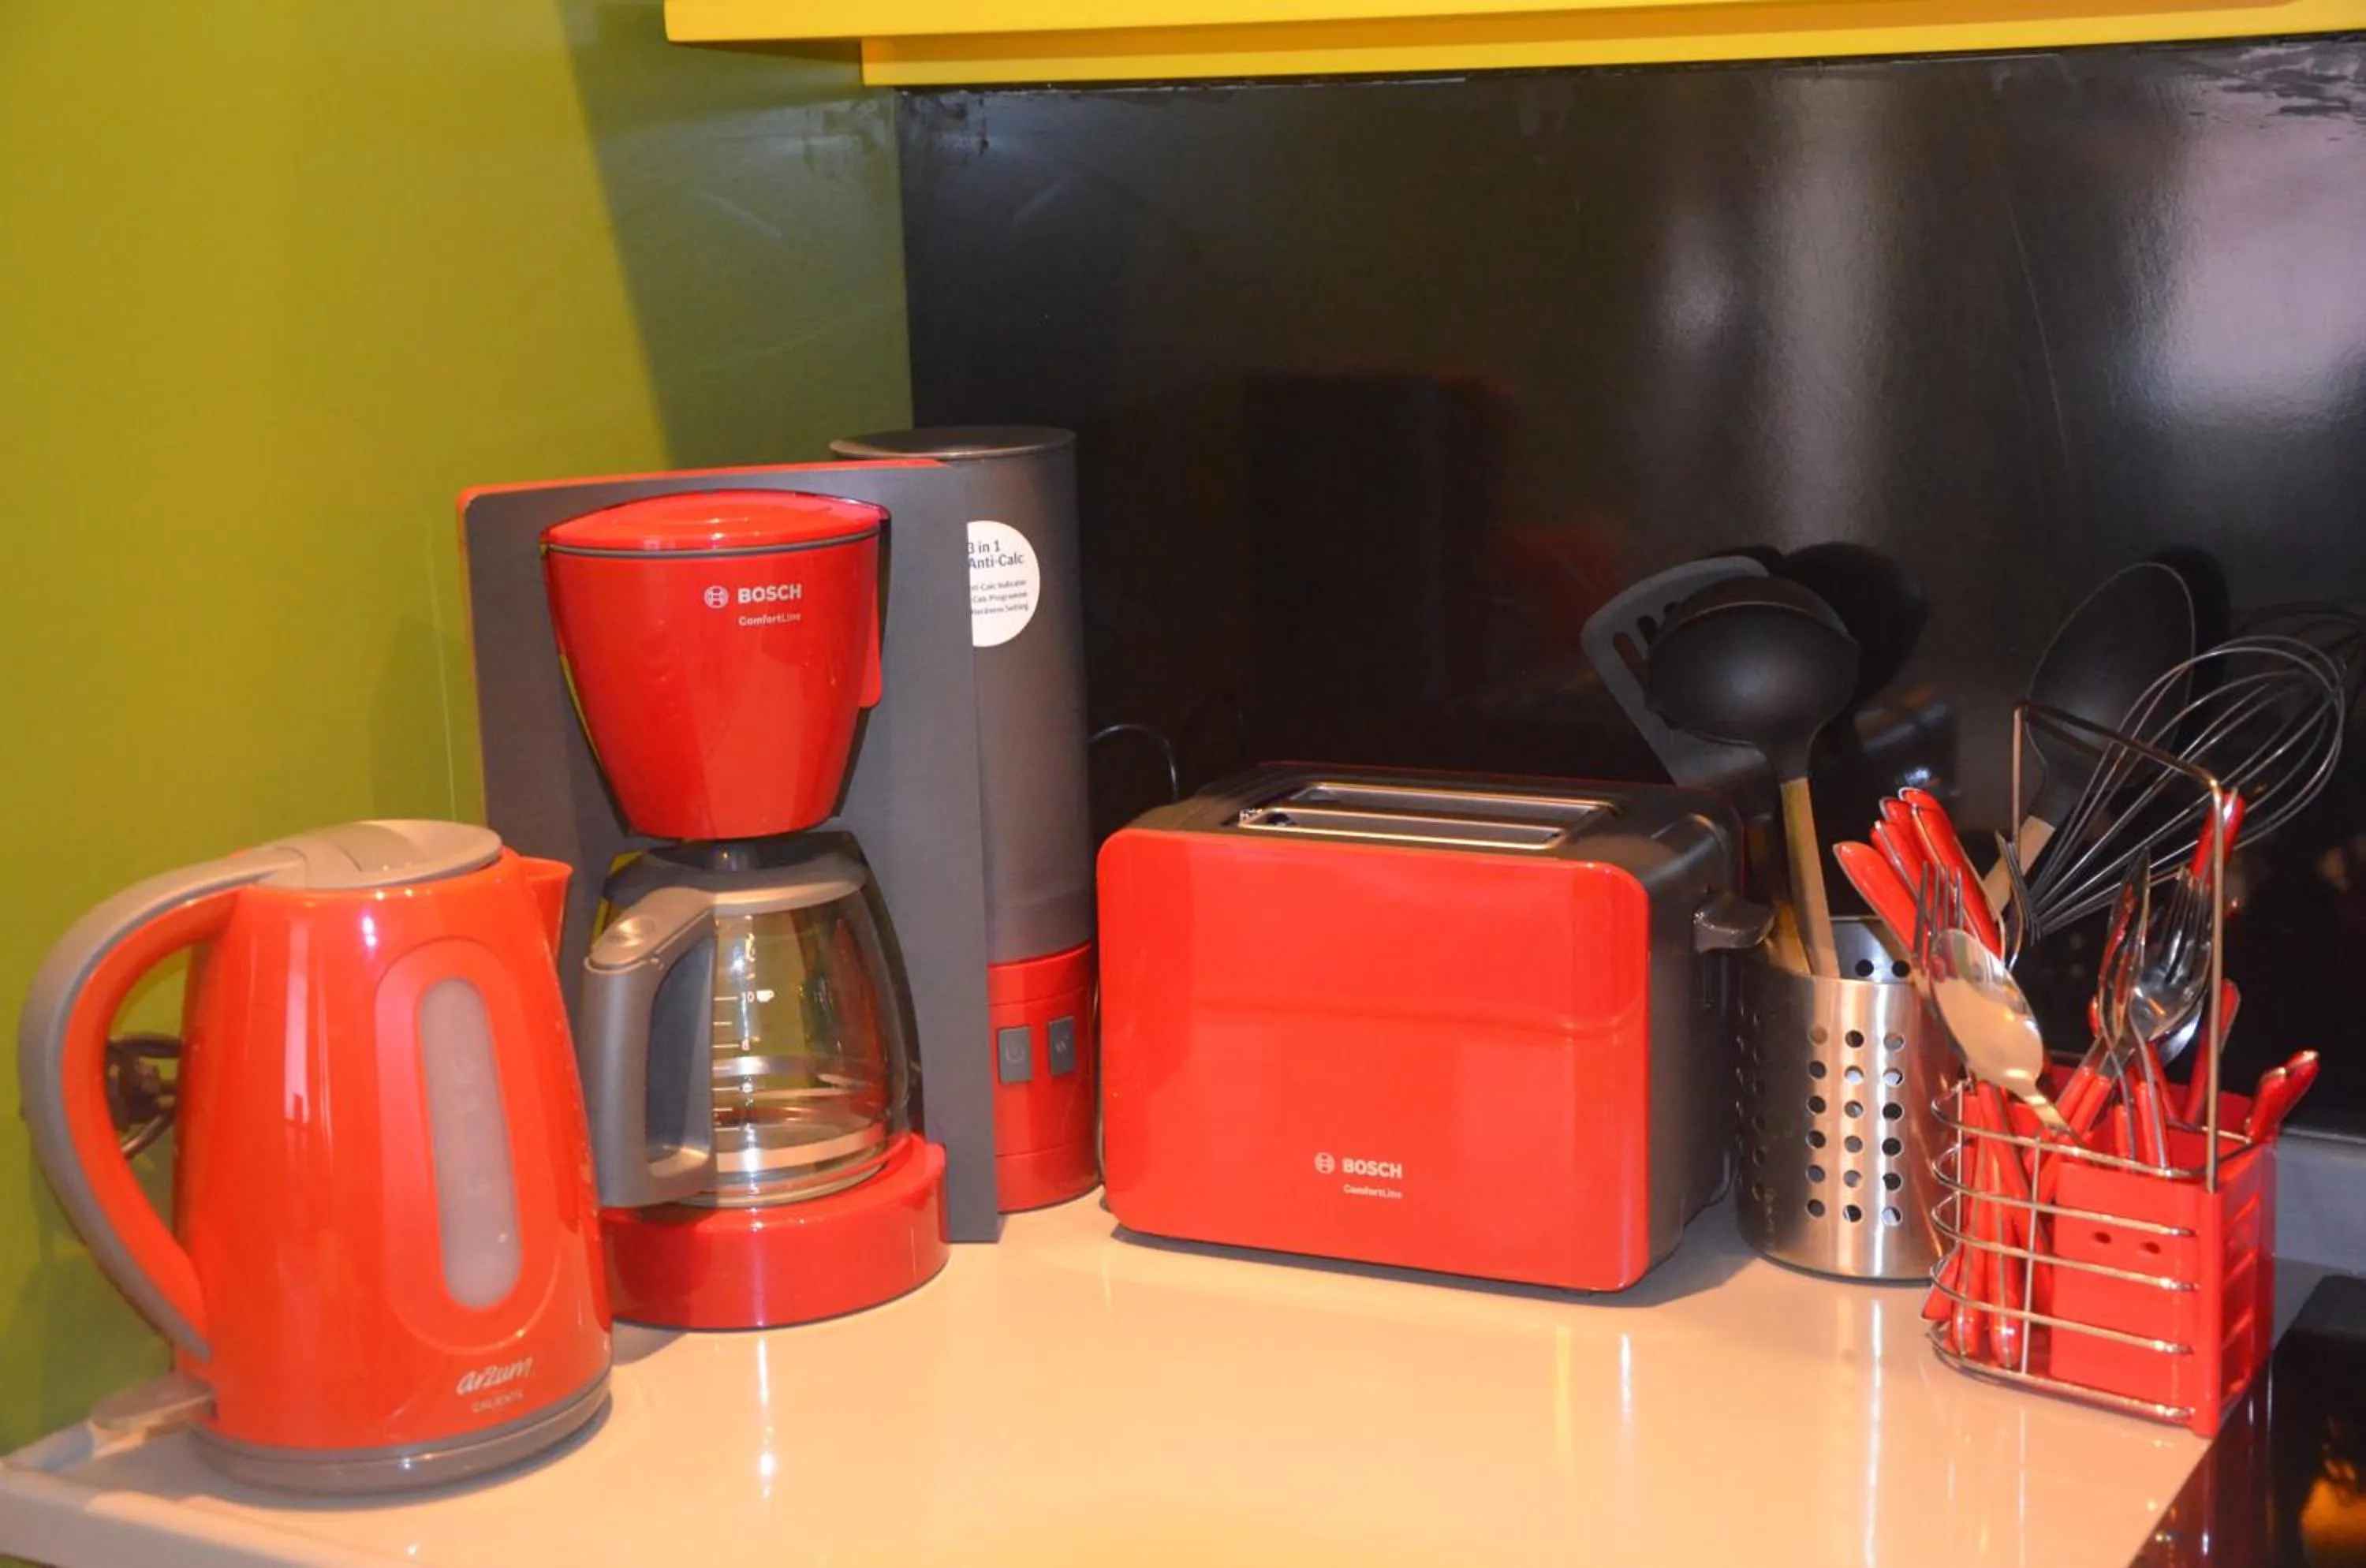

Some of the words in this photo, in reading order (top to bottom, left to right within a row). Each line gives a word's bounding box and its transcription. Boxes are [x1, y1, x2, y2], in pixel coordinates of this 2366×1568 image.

[979, 541, 989, 554] in
[994, 539, 1000, 553] 1
[970, 551, 1024, 569] Anti-Calc
[737, 584, 803, 604] BOSCH
[738, 613, 802, 626] ComfortLine
[1342, 1157, 1403, 1179] BOSCH
[1342, 1183, 1404, 1199] ComfortLine
[457, 1356, 534, 1396] arzum
